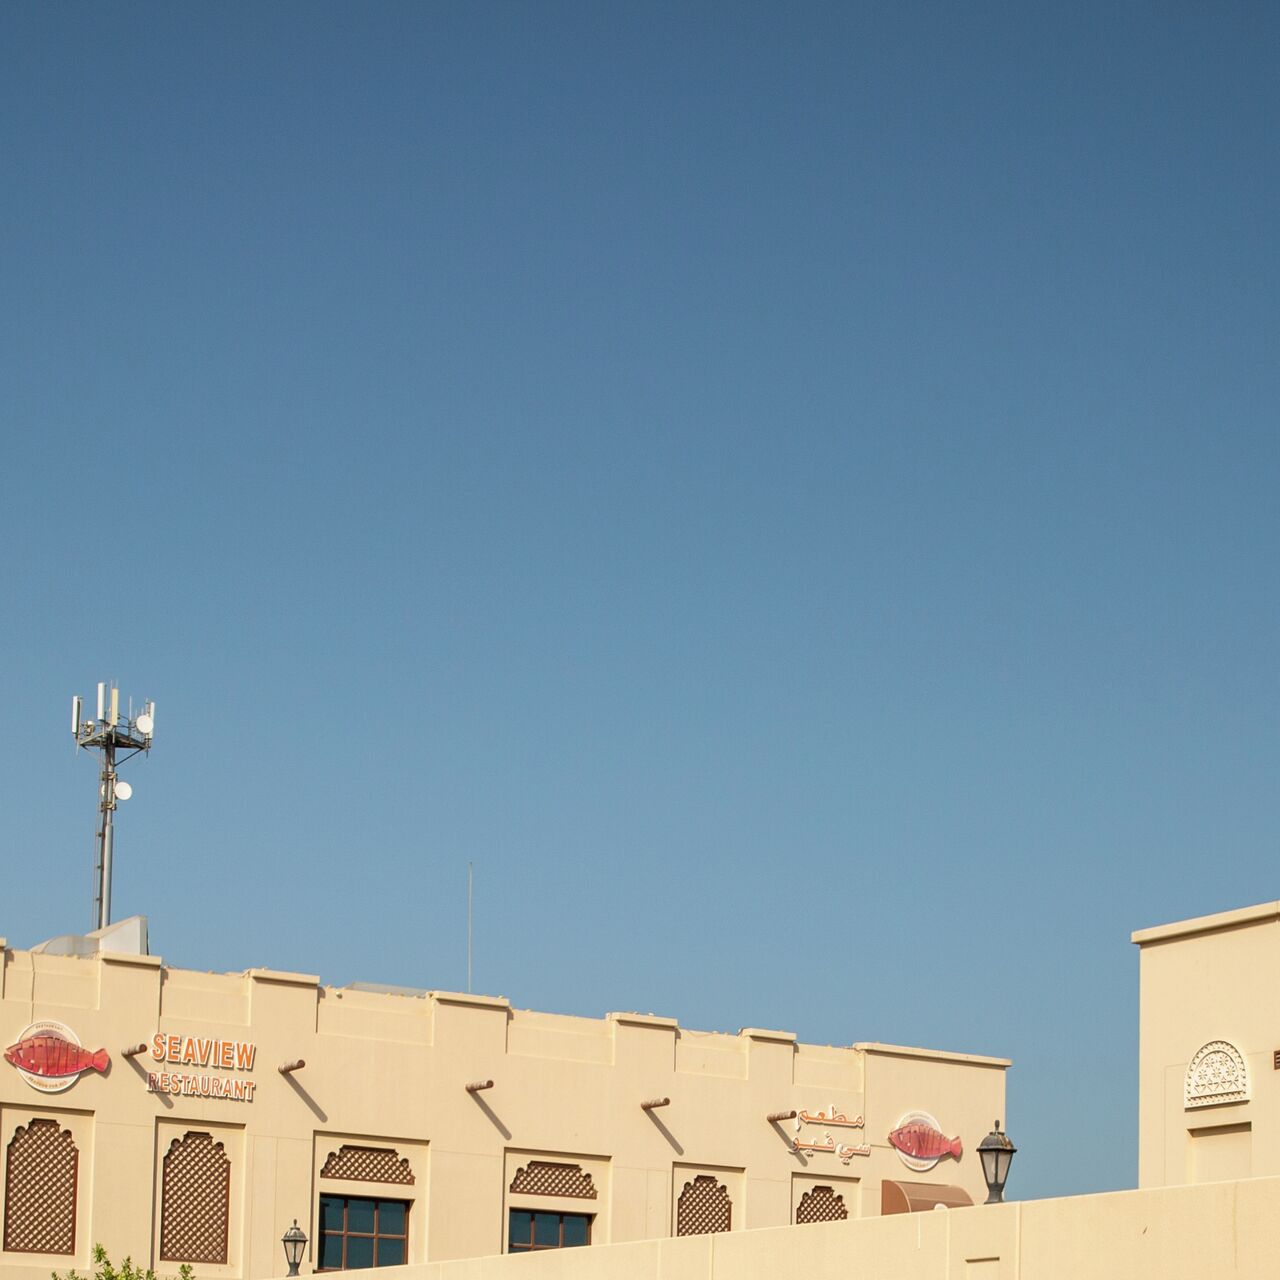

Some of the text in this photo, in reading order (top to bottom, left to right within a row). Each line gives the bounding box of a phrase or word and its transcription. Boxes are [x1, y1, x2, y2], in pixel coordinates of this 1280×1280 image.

[151, 1032, 255, 1071] SEAVIEW
[146, 1071, 255, 1102] RESTAURANT
[796, 1104, 865, 1131] مطعم
[788, 1131, 871, 1165] سي فيو
